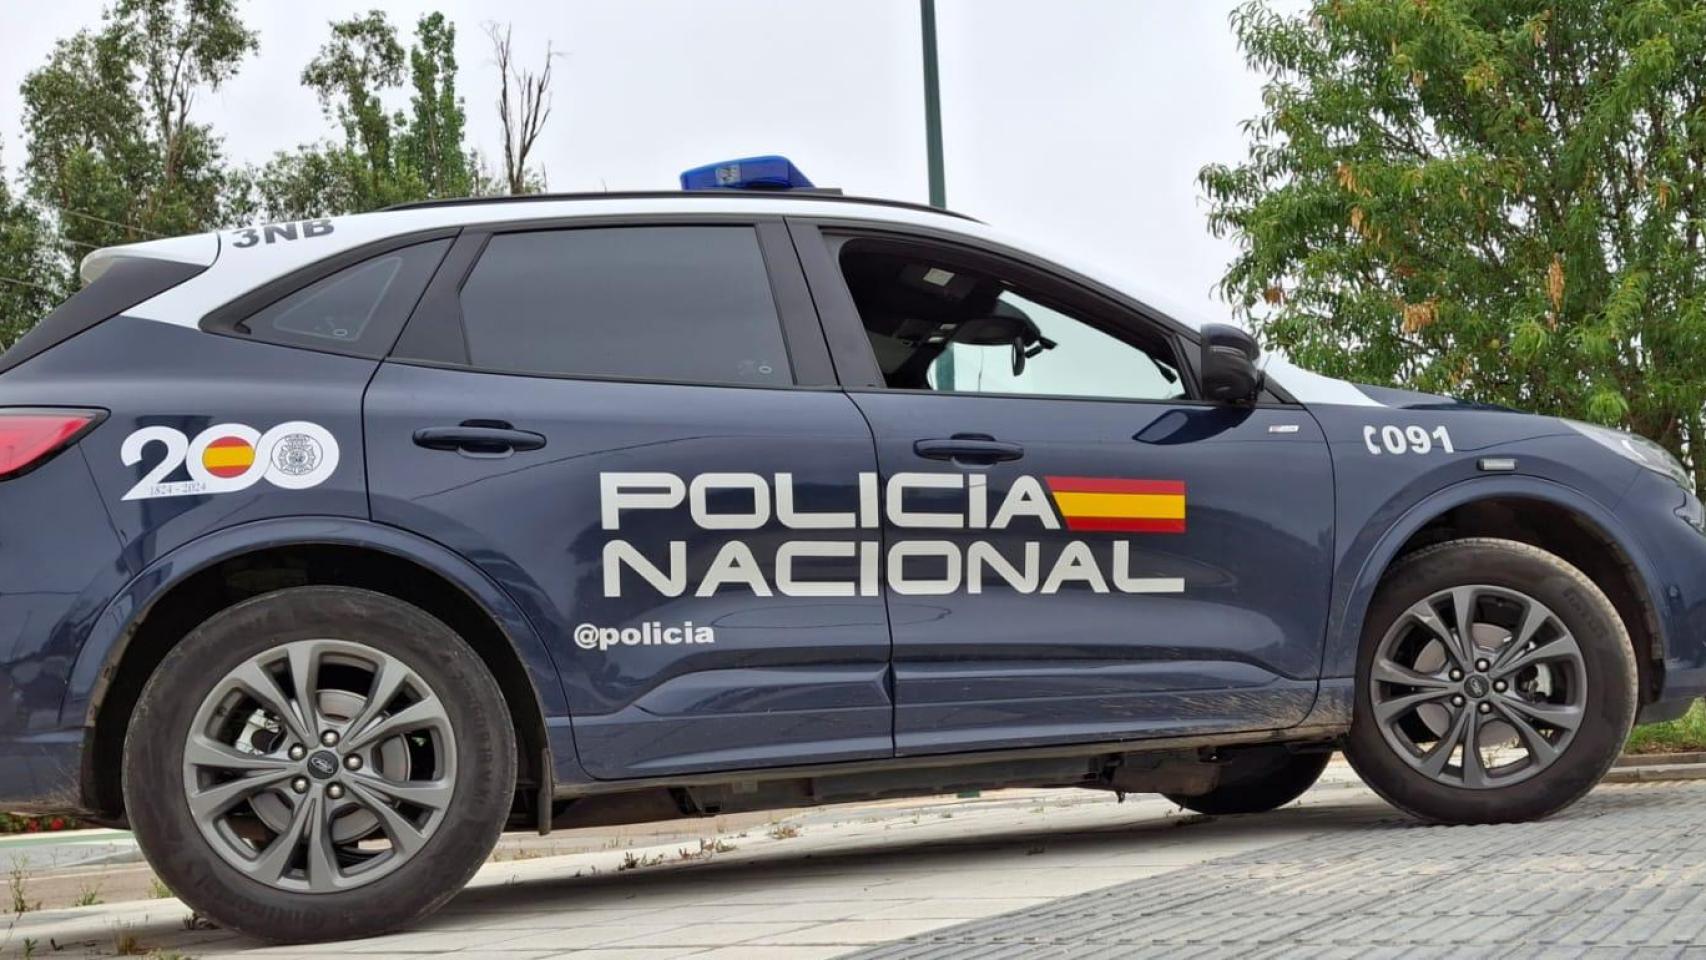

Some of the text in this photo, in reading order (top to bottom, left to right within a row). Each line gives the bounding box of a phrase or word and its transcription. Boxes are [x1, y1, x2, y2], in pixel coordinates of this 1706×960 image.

[232, 219, 335, 248] 3NB
[1382, 425, 1454, 454] 091
[121, 421, 340, 501] 200
[149, 485, 172, 497] 1824
[183, 481, 206, 494] 2024
[603, 539, 1184, 597] NACIONAL
[574, 621, 714, 650] @policia
